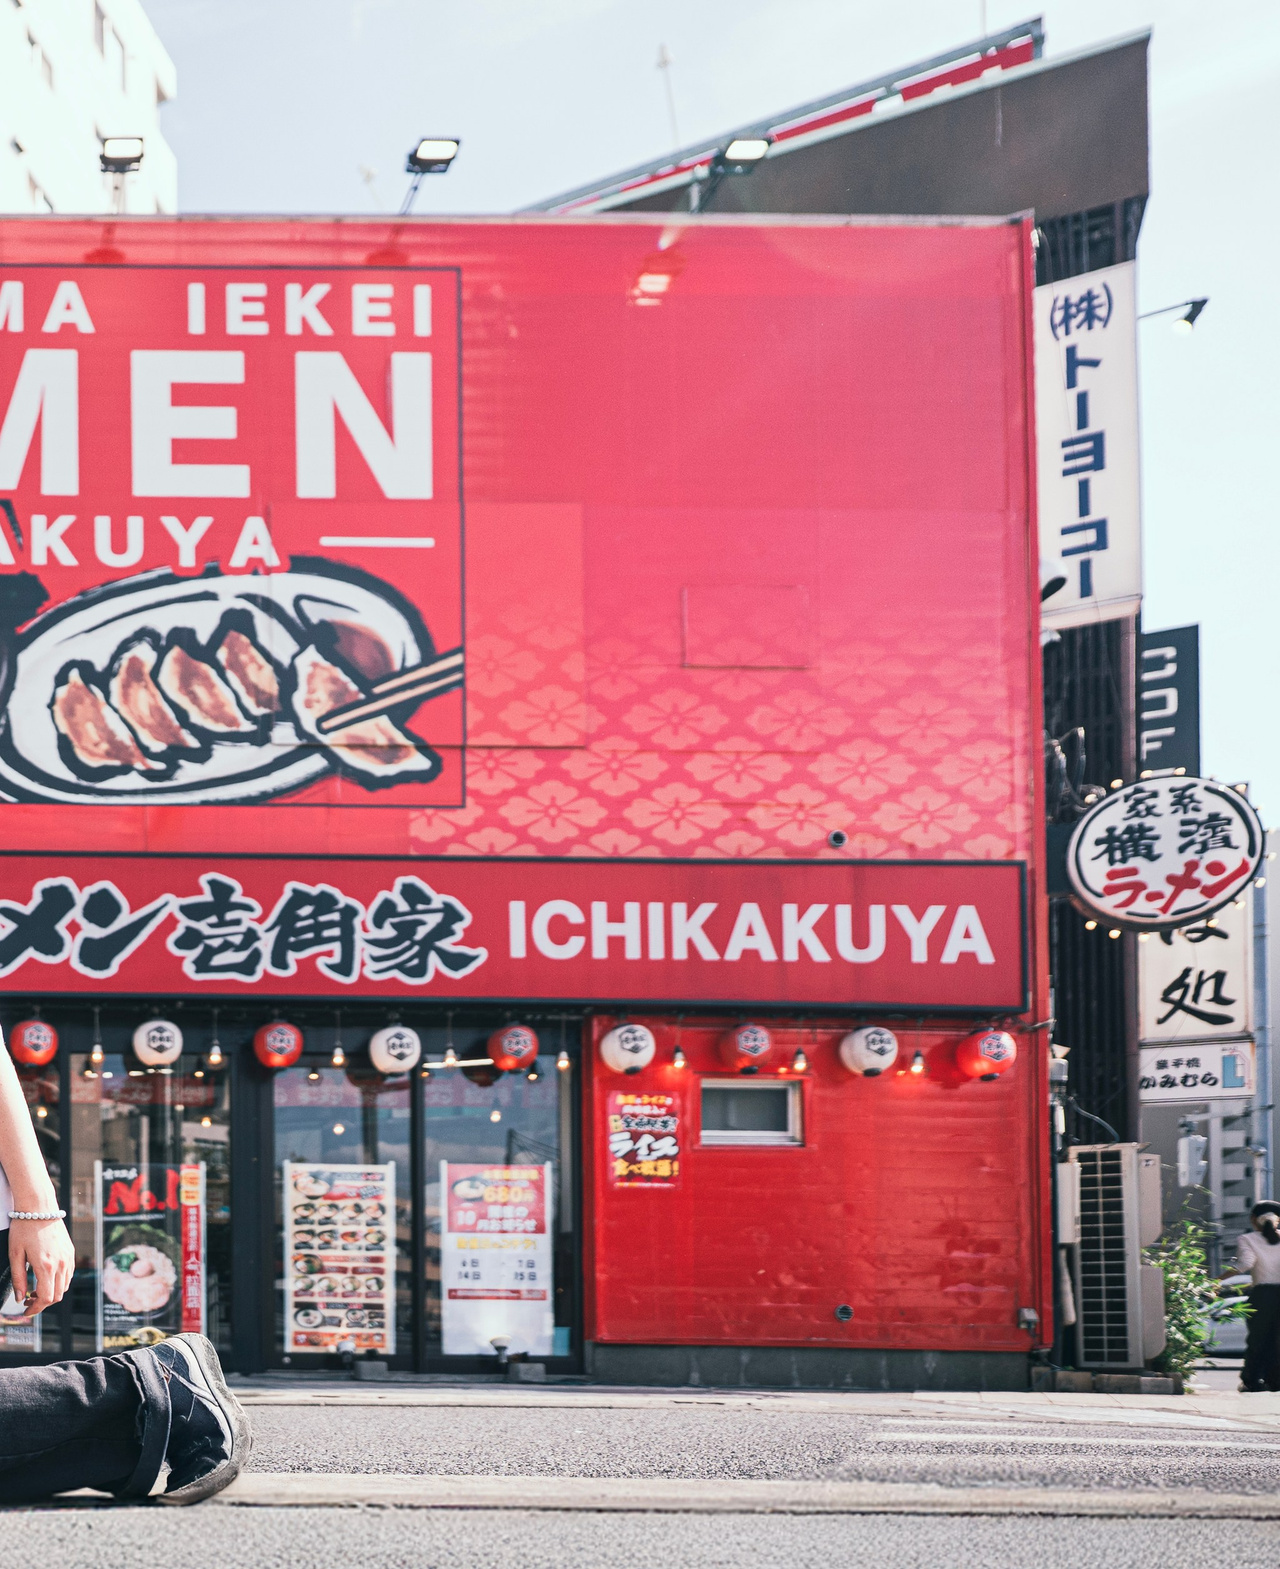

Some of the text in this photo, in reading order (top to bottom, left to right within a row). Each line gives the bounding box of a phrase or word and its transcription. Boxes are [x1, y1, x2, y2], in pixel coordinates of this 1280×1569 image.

[187, 282, 433, 338] IEKEI
[1141, 645, 1178, 779] COF
[1102, 857, 1251, 914] ラーメン
[508, 898, 996, 966] ICHIKAKUYA
[608, 1131, 680, 1159] ライス
